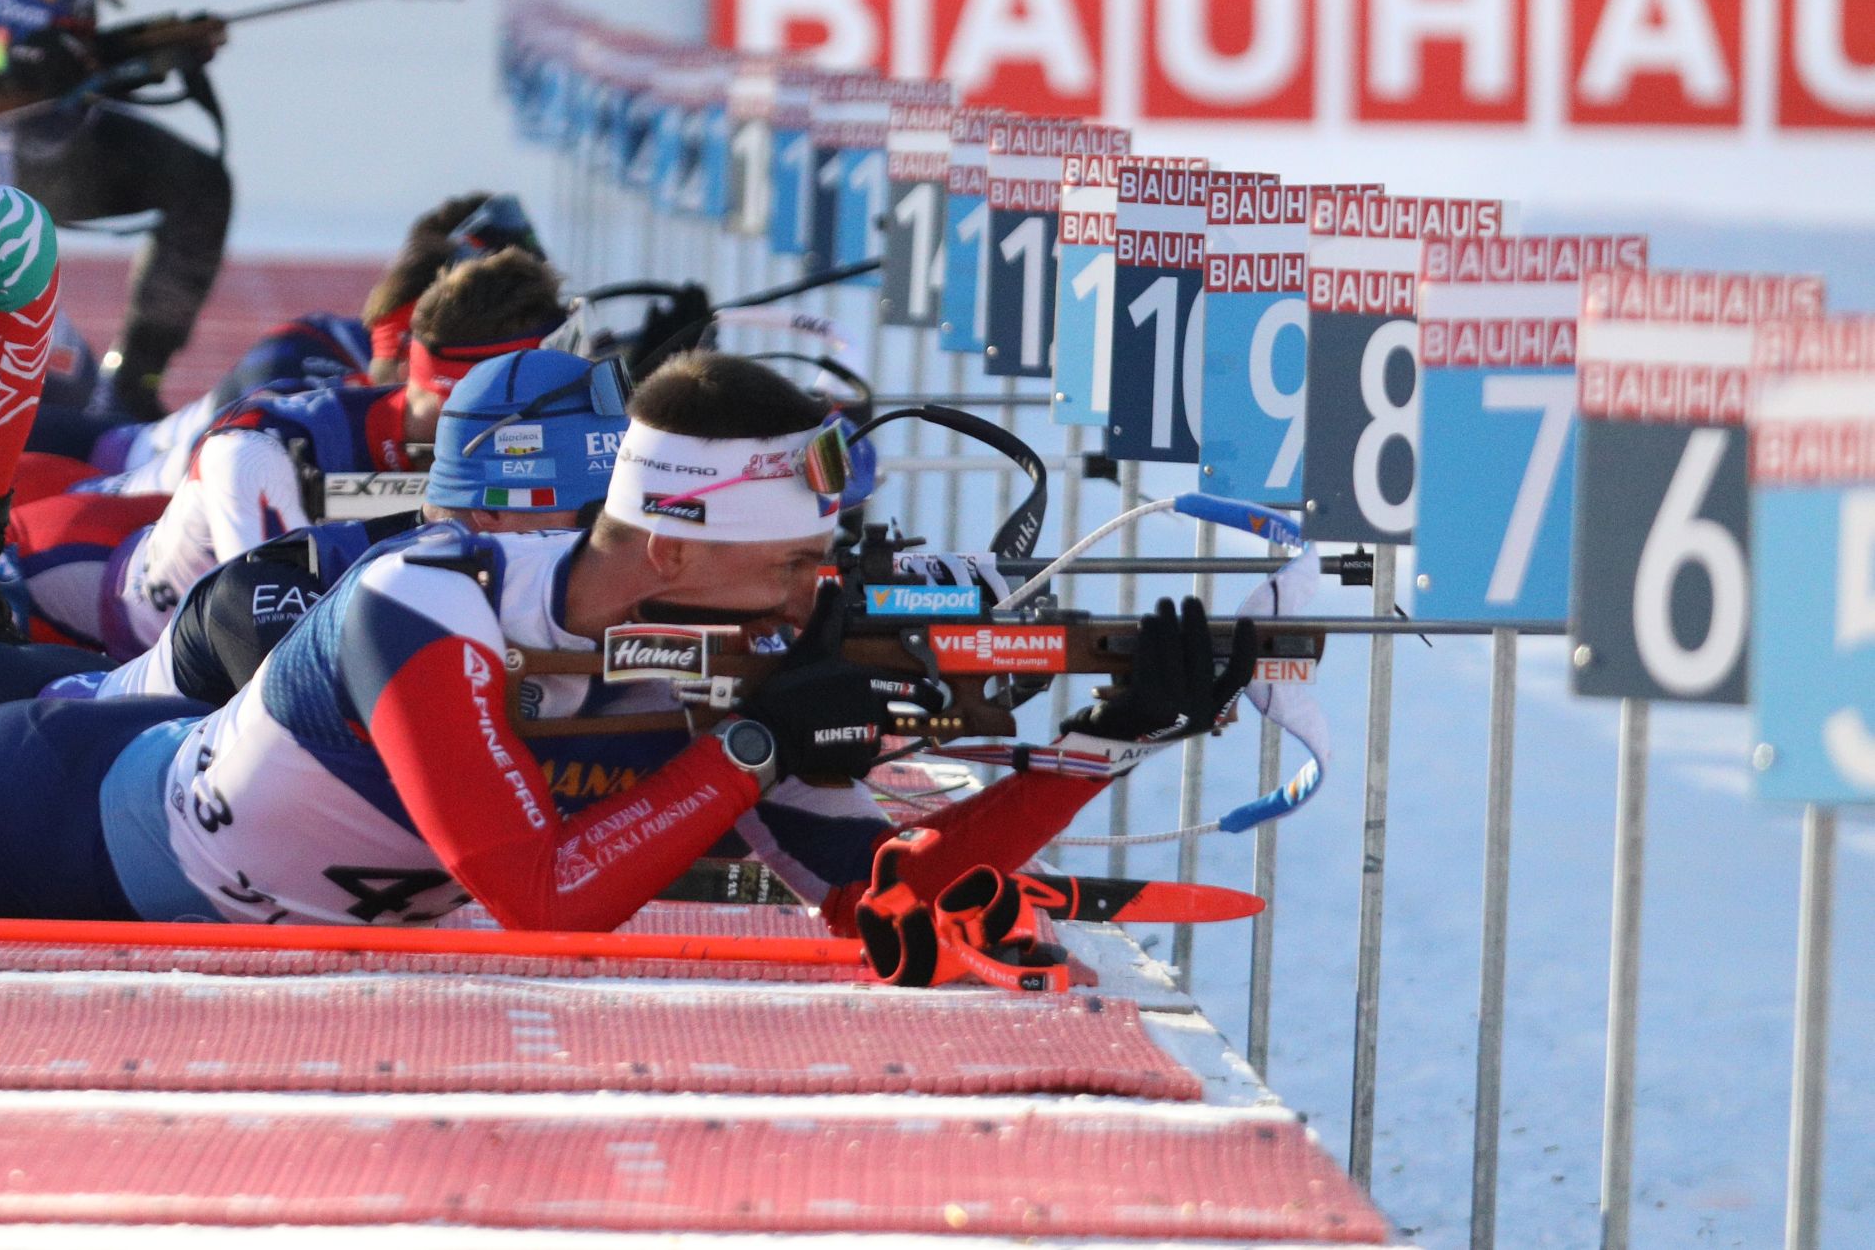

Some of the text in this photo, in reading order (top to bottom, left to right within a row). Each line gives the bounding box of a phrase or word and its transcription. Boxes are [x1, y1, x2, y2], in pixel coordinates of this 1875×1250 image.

[990, 129, 1128, 155] BAUHAUS
[1313, 195, 1499, 237] BAUHAUS
[1248, 298, 1306, 488] 9
[1352, 318, 1417, 534] 8
[501, 460, 536, 475] EA7
[675, 464, 719, 477] PRO
[1481, 375, 1576, 604] 7
[1633, 426, 1750, 697] 6
[893, 588, 977, 611] Tipsport
[613, 638, 696, 667] Hamé
[505, 768, 548, 831] PRO
